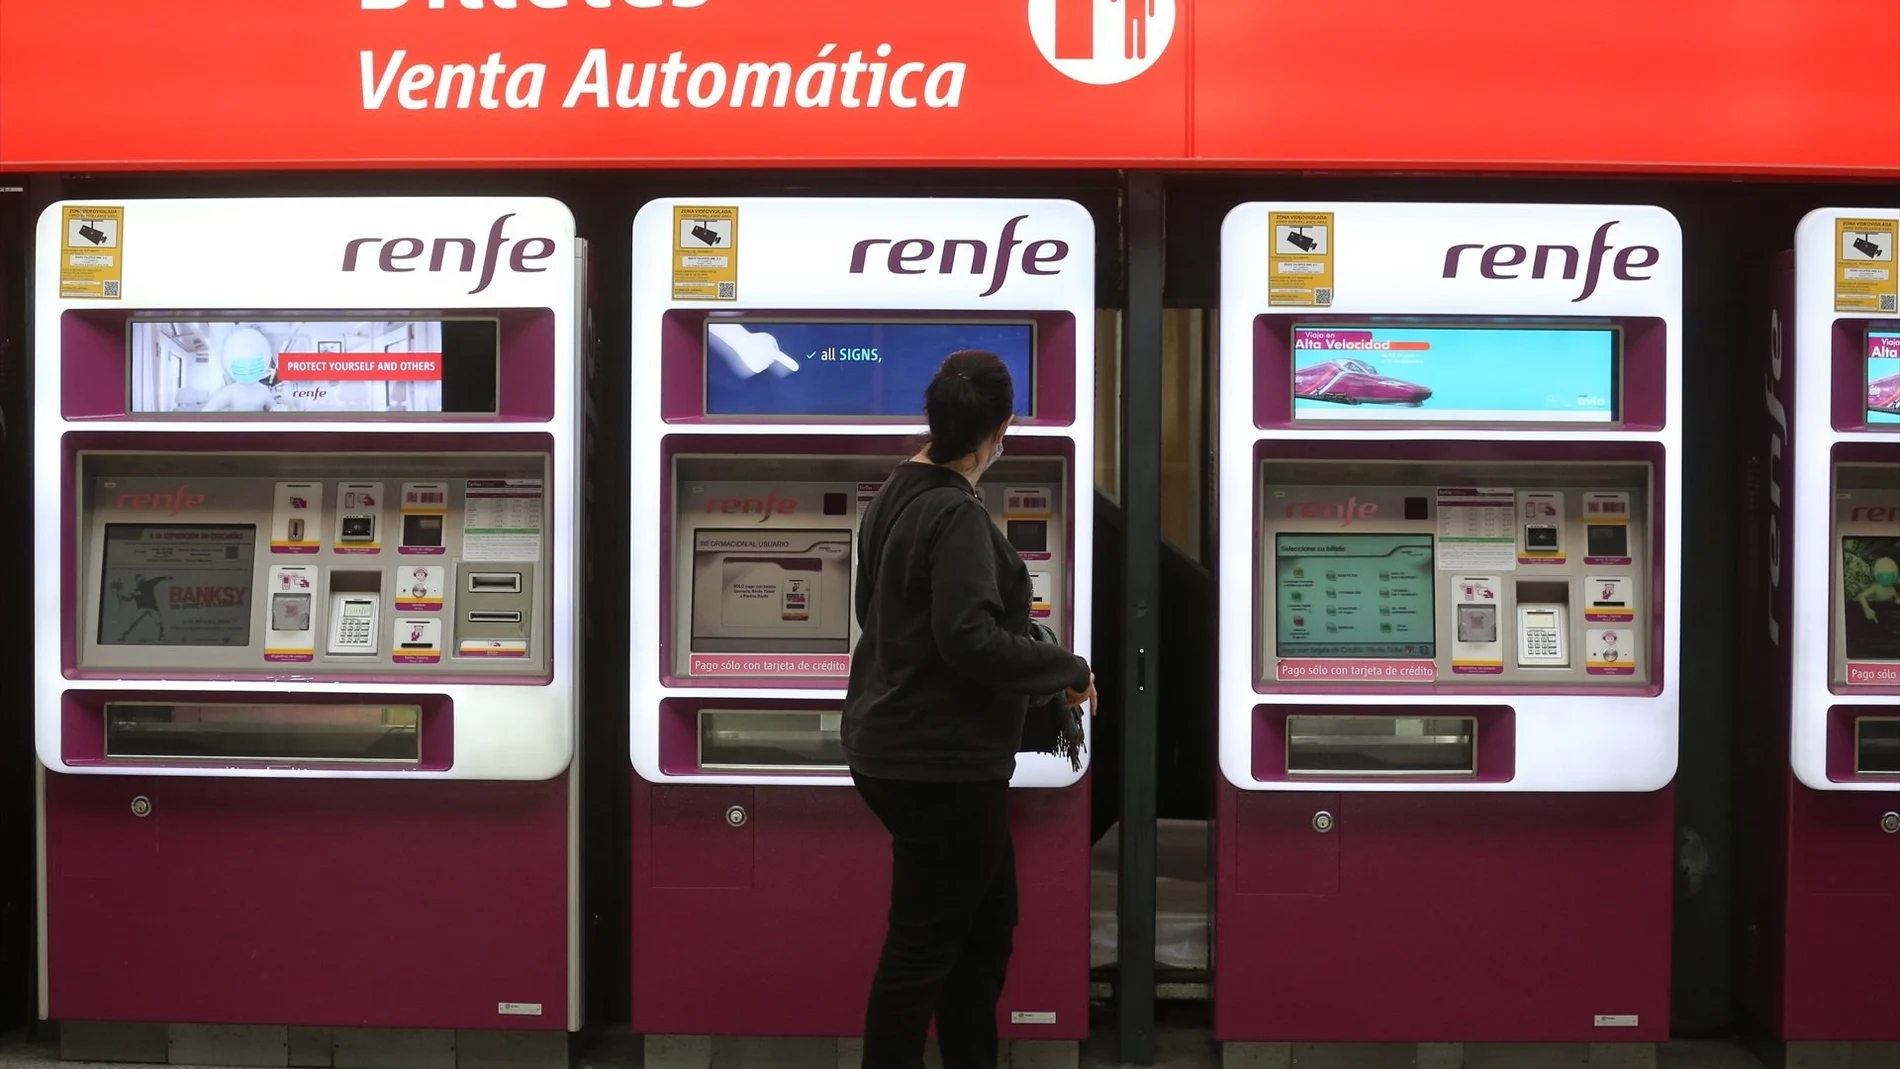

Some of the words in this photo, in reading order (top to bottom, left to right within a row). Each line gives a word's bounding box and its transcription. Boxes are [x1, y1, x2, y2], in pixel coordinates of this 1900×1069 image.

[360, 50, 546, 110] Venta
[561, 43, 967, 110] Automática
[342, 213, 556, 295] renfe
[849, 214, 1070, 297] renfe
[1442, 220, 1660, 303] renfe
[1305, 331, 1323, 340] Viaja
[1881, 338, 1900, 348] Viaja
[1295, 339, 1321, 350] Alta
[1325, 339, 1390, 350] Velocidad
[1871, 346, 1898, 358] Alta
[821, 347, 836, 361] all
[839, 348, 882, 364] SIGNS,
[287, 361, 327, 371] PROTECT
[329, 361, 375, 371] YOURSELF
[377, 361, 397, 371] AND
[400, 361, 435, 371] OTHERS
[293, 386, 327, 401] renfe
[1763, 308, 1789, 647] renfe
[116, 484, 206, 517] renfe
[705, 488, 798, 523] renfe
[1285, 494, 1379, 527] renfe
[169, 586, 249, 604] BANKSY
[695, 660, 718, 672] Pago
[721, 659, 740, 670] sólo
[743, 662, 760, 670] con
[764, 661, 795, 672] tarjeta
[798, 661, 810, 670] de
[812, 660, 846, 671] crédito
[1282, 665, 1306, 677] Pago
[1308, 665, 1328, 675] sólo
[1331, 667, 1348, 675] con
[1351, 665, 1382, 677] tarjeta
[1385, 665, 1397, 675] de
[1400, 665, 1433, 676] crédito
[1851, 668, 1875, 681] Pago
[1877, 668, 1897, 679] sólo
